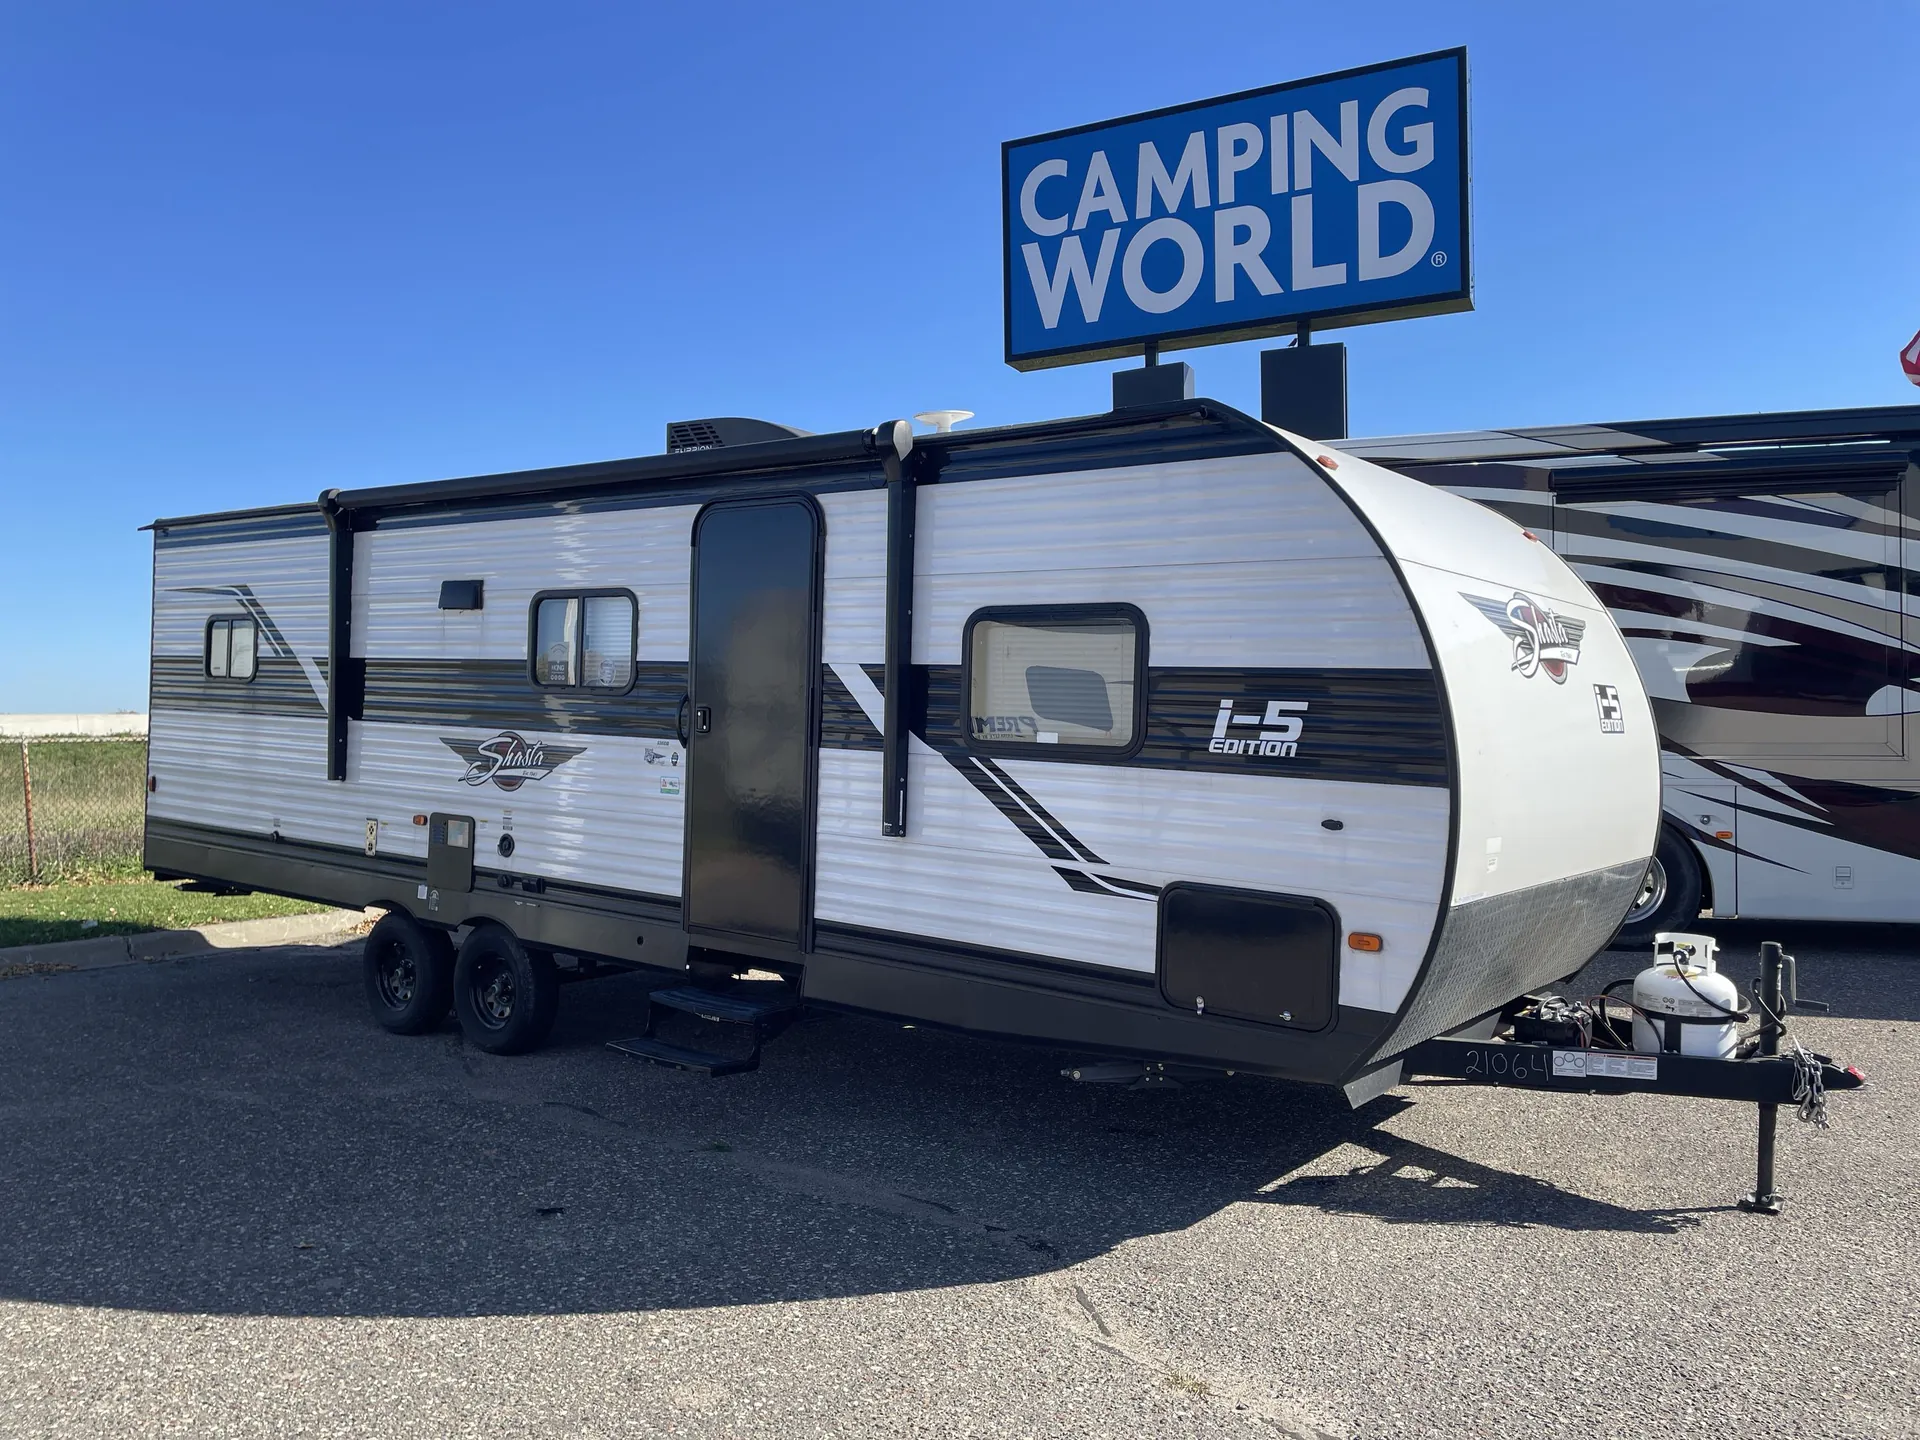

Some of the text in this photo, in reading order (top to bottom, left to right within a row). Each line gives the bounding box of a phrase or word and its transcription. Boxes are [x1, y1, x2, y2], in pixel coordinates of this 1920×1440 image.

[1020, 87, 1434, 237] CAMPING
[1021, 179, 1435, 330] WORLD
[458, 736, 549, 786] Shasta
[1208, 738, 1298, 757] EDITION
[1466, 1050, 1549, 1081] 21064
